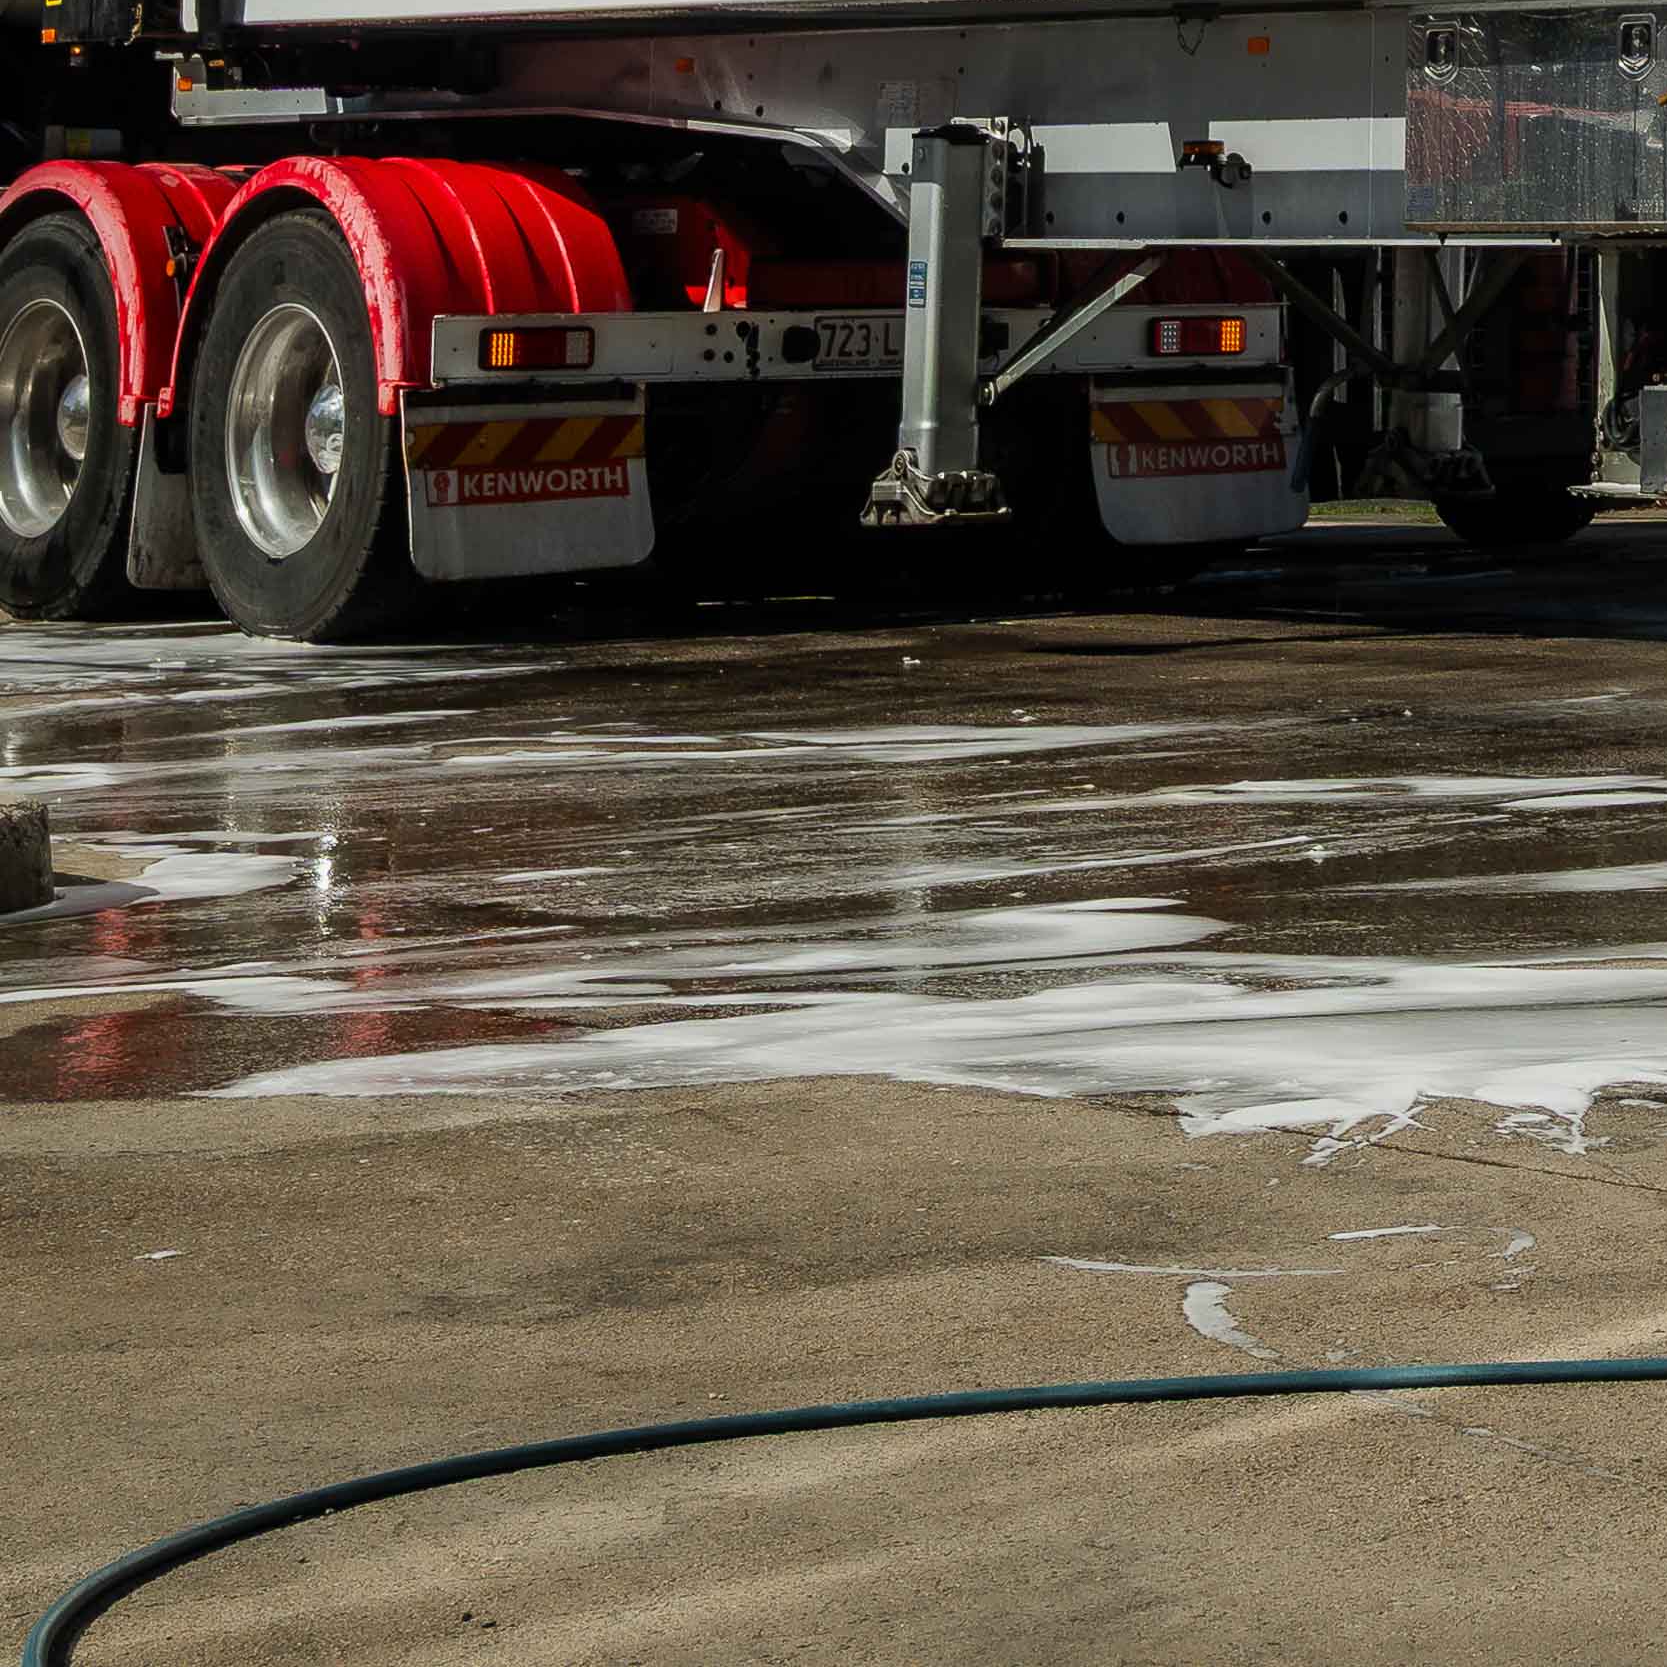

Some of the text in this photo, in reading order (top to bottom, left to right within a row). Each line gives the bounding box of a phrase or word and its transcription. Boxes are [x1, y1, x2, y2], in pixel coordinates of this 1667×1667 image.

[821, 323, 872, 358] 723
[1141, 443, 1281, 470] KENWORTH
[463, 466, 624, 498] KENWORTH
